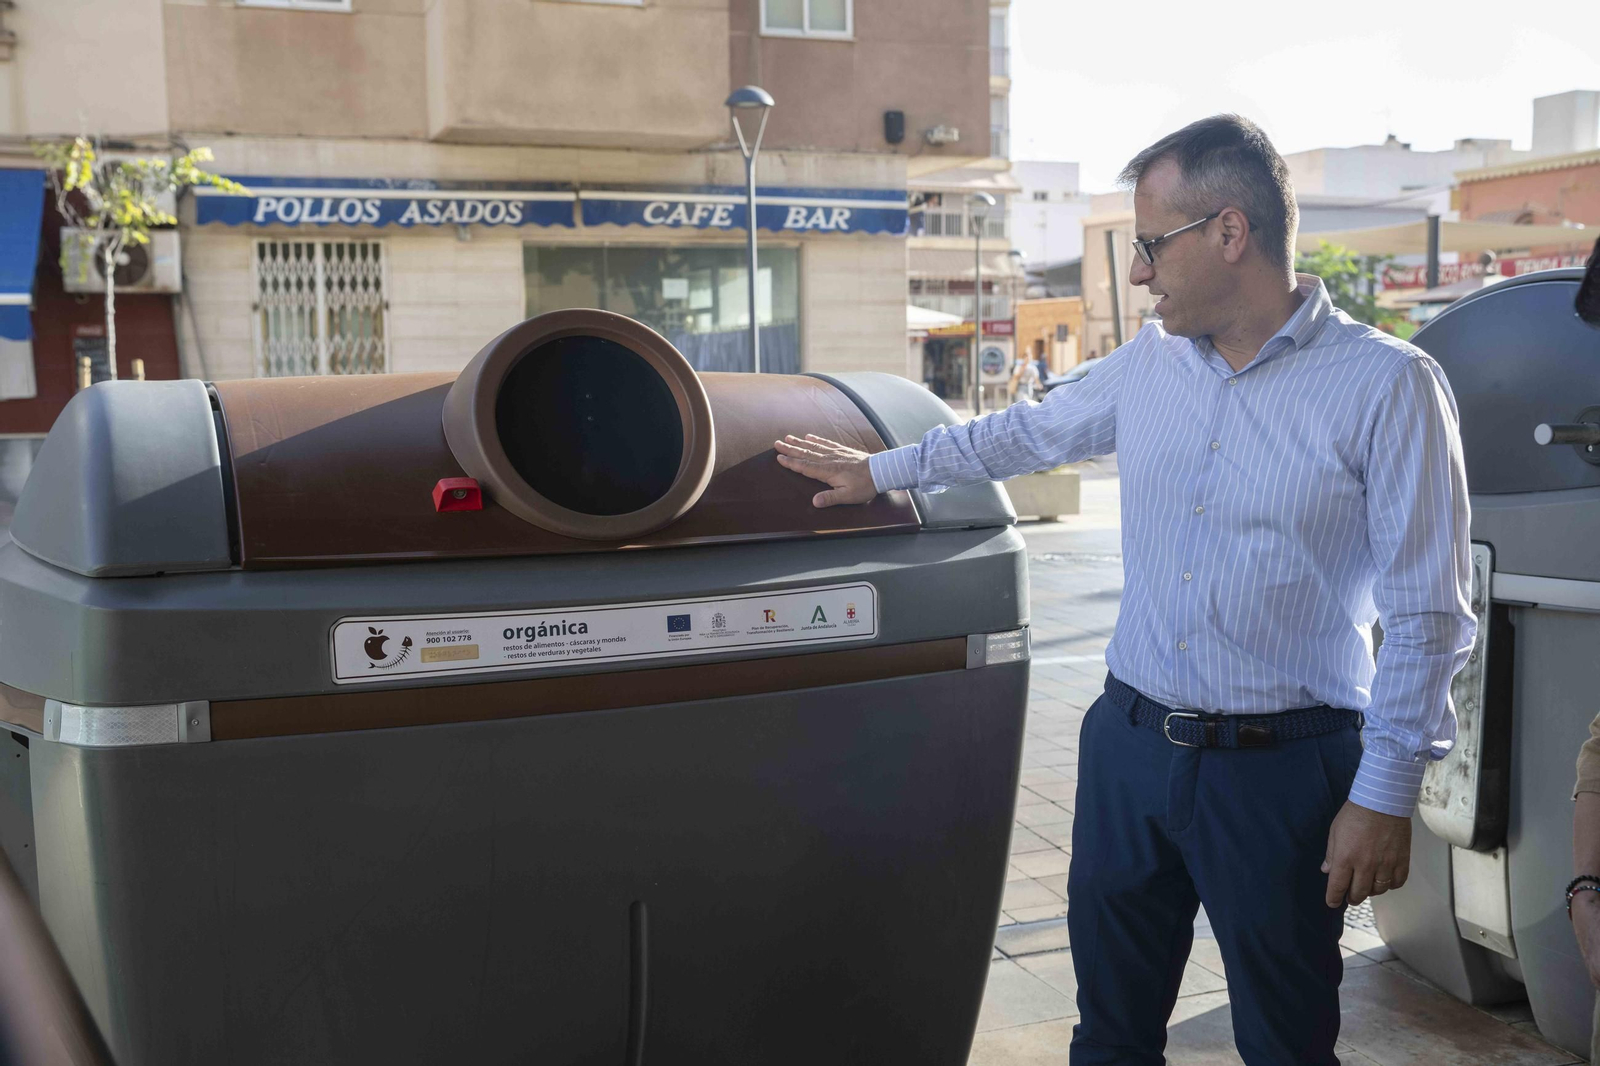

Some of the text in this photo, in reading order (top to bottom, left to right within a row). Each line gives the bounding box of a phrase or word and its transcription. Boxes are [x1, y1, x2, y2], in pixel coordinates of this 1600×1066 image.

[253, 196, 525, 225] POLLOS ASADOS
[642, 200, 851, 231] CAFE BAR
[442, 635, 457, 643] 102
[457, 634, 472, 642] 778
[503, 619, 588, 643] orgánica
[503, 643, 523, 652] restos
[533, 640, 565, 650] alimentos
[569, 638, 596, 647] cáscaras
[601, 635, 627, 644] mondas
[507, 652, 527, 660] restos
[528, 649, 537, 658] de
[537, 647, 566, 657] verduras
[571, 645, 602, 655] vegetales
